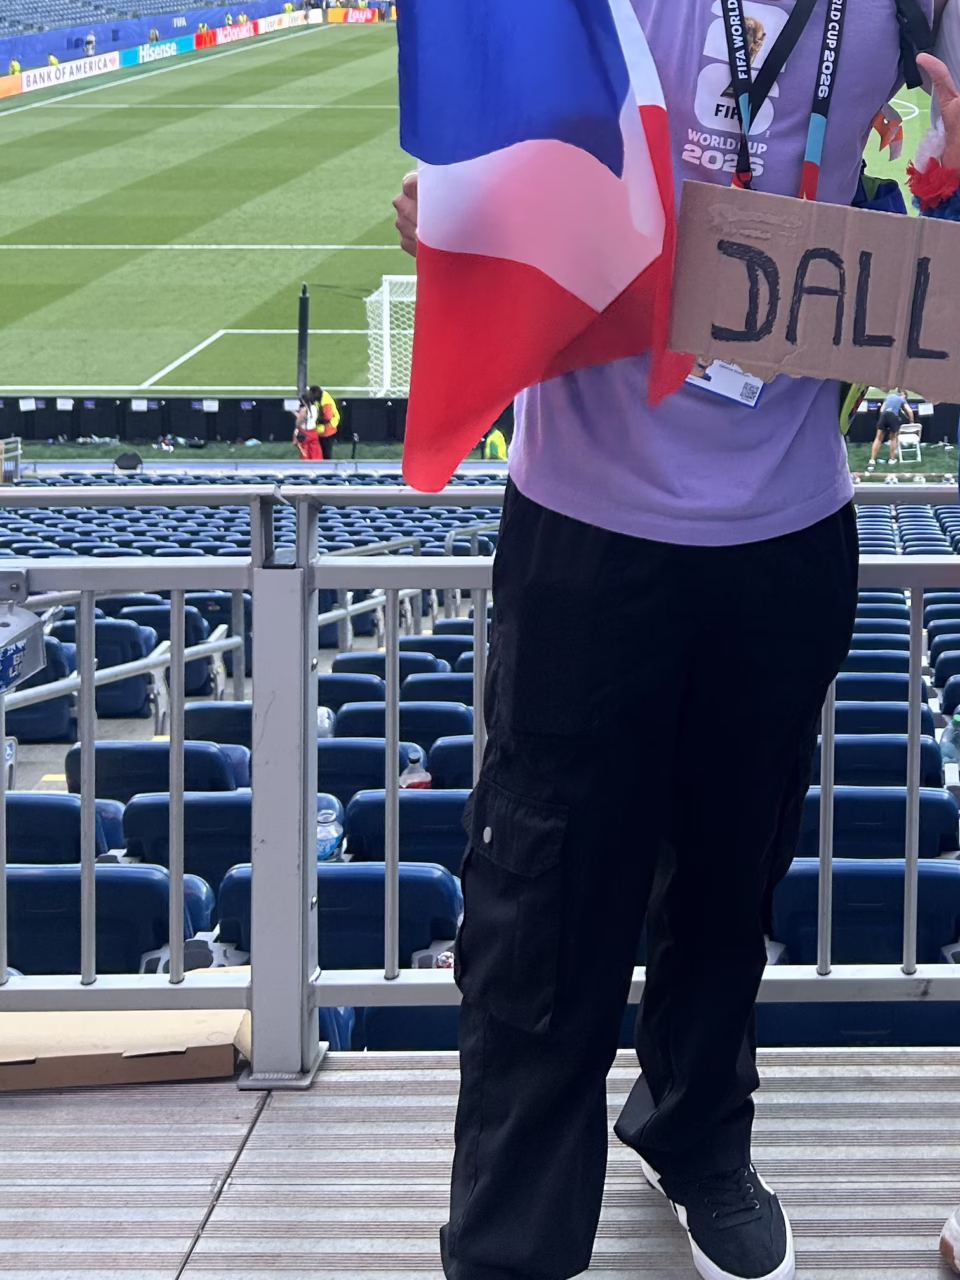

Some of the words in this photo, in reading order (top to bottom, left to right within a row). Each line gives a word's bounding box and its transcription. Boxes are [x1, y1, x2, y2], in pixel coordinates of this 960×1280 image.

[173, 17, 187, 28] FIFA
[216, 20, 255, 45] McDonald's
[826, 21, 839, 49] CUP
[138, 41, 177, 64] Hisense
[735, 49, 748, 79] FIFA
[25, 71, 51, 89] BANK
[55, 65, 67, 81] OF
[69, 57, 108, 78] AMERICA
[818, 49, 835, 98] 2026
[687, 128, 737, 150] WORLD
